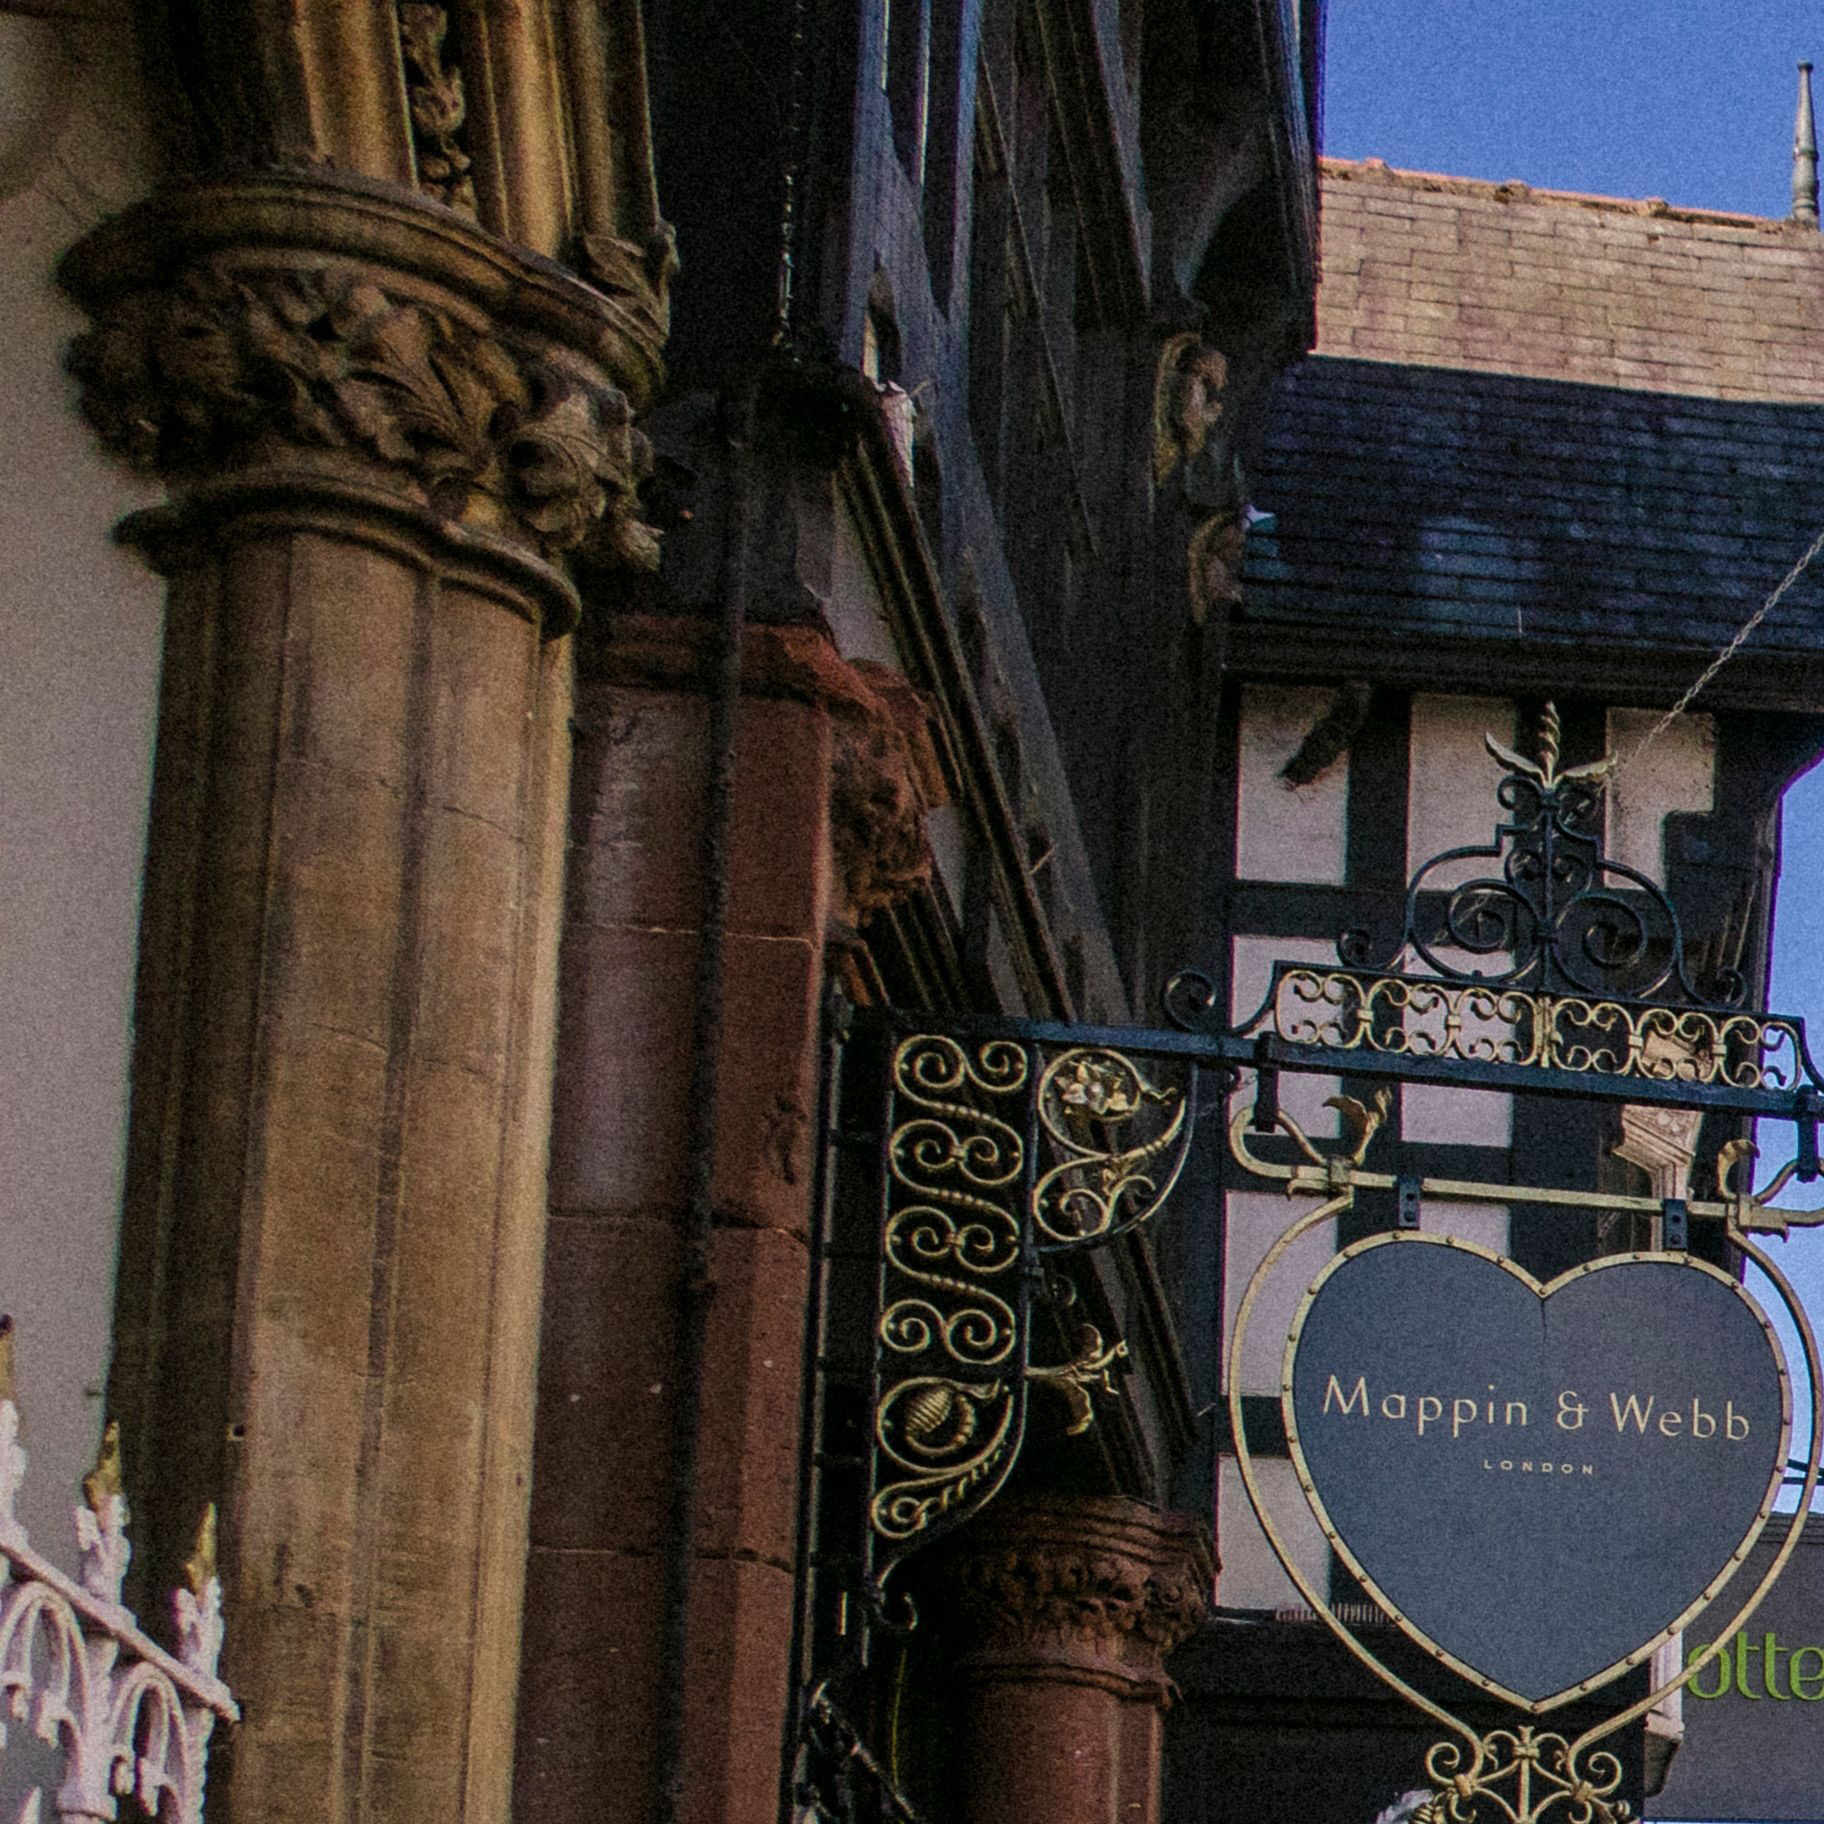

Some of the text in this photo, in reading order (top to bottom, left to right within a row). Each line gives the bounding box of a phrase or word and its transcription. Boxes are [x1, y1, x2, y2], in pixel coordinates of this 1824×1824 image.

[1323, 1374, 1750, 1441] Mappin & Webb
[1483, 1458, 1594, 1476] LONDON
